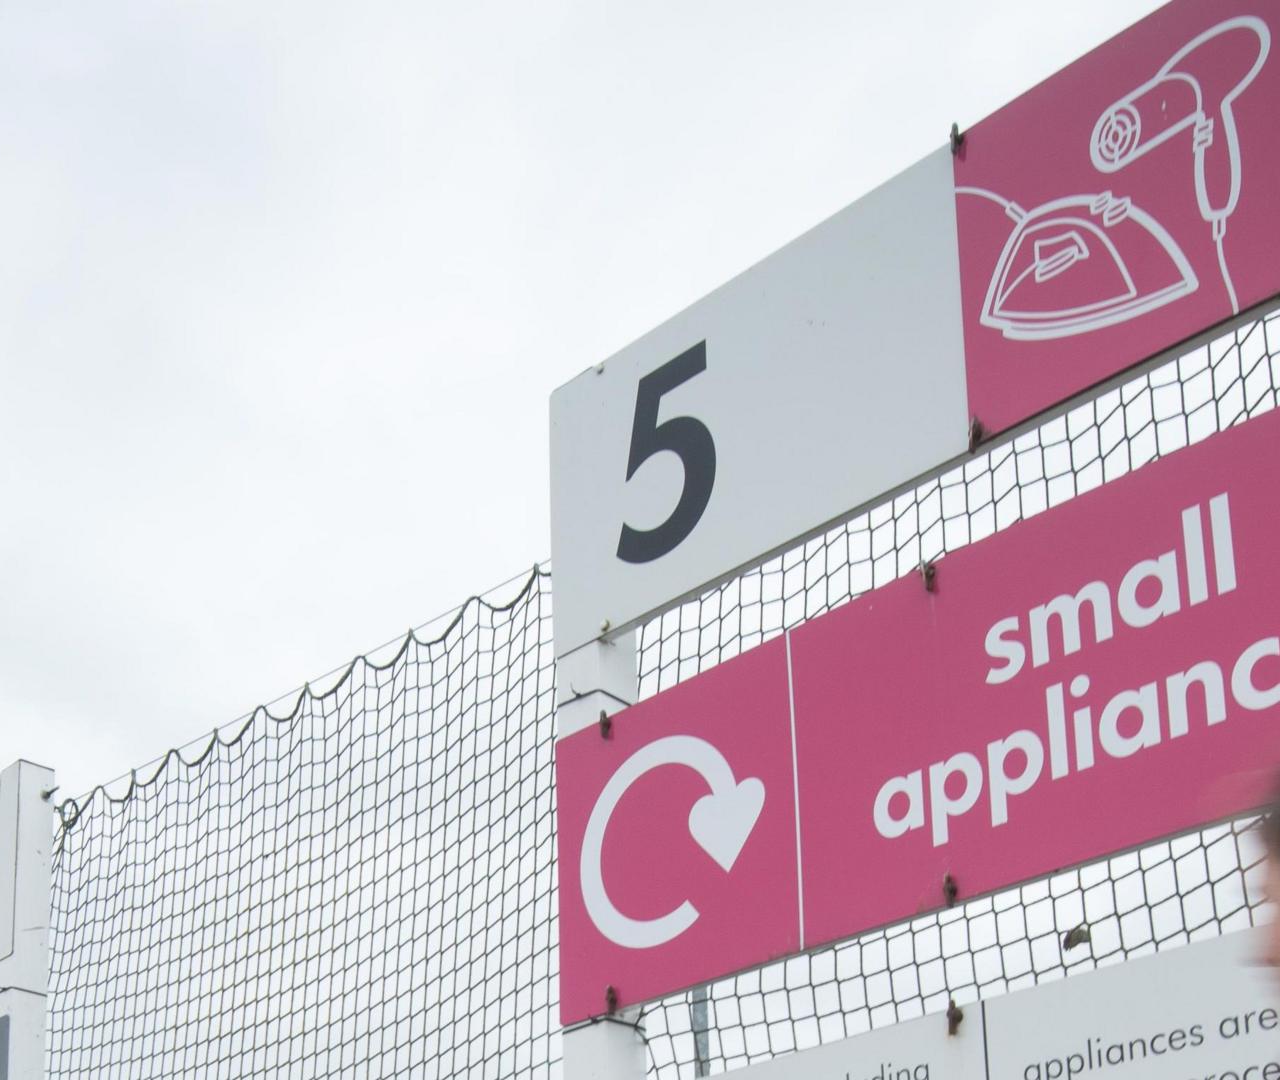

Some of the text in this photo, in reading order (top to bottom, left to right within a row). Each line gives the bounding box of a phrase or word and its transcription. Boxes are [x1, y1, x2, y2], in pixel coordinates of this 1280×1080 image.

[615, 339, 718, 565] 5
[984, 491, 1239, 686] small
[1218, 1006, 1279, 1039] are
